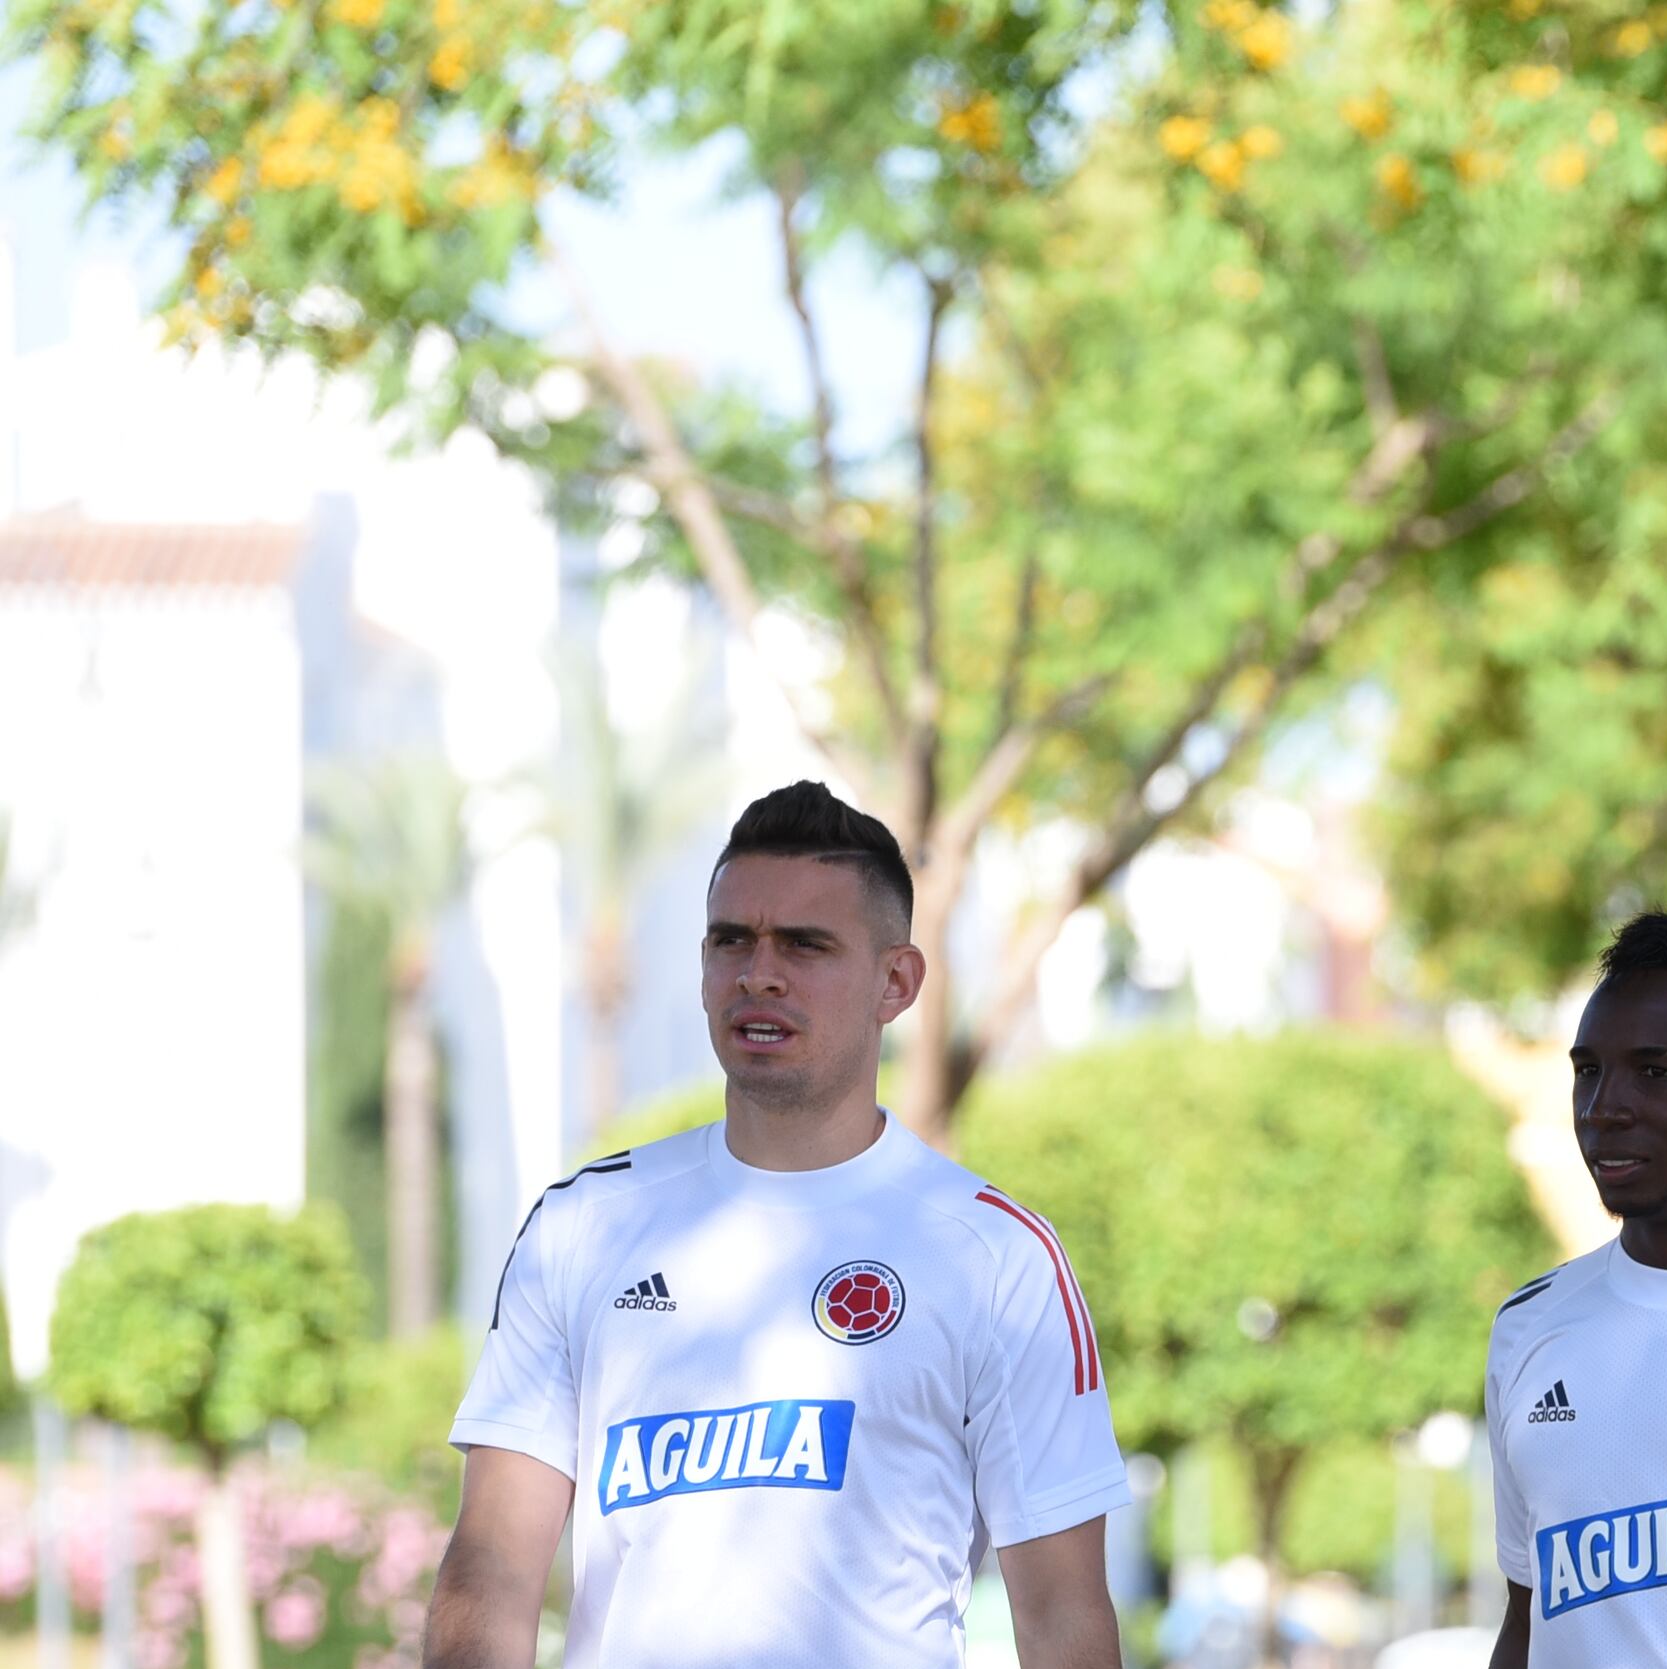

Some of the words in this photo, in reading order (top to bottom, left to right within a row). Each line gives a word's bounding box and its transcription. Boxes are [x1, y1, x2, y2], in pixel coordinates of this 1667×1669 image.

[614, 1294, 677, 1312] adidas
[1528, 1406, 1576, 1424] adidas
[606, 1405, 828, 1507] AGUILA
